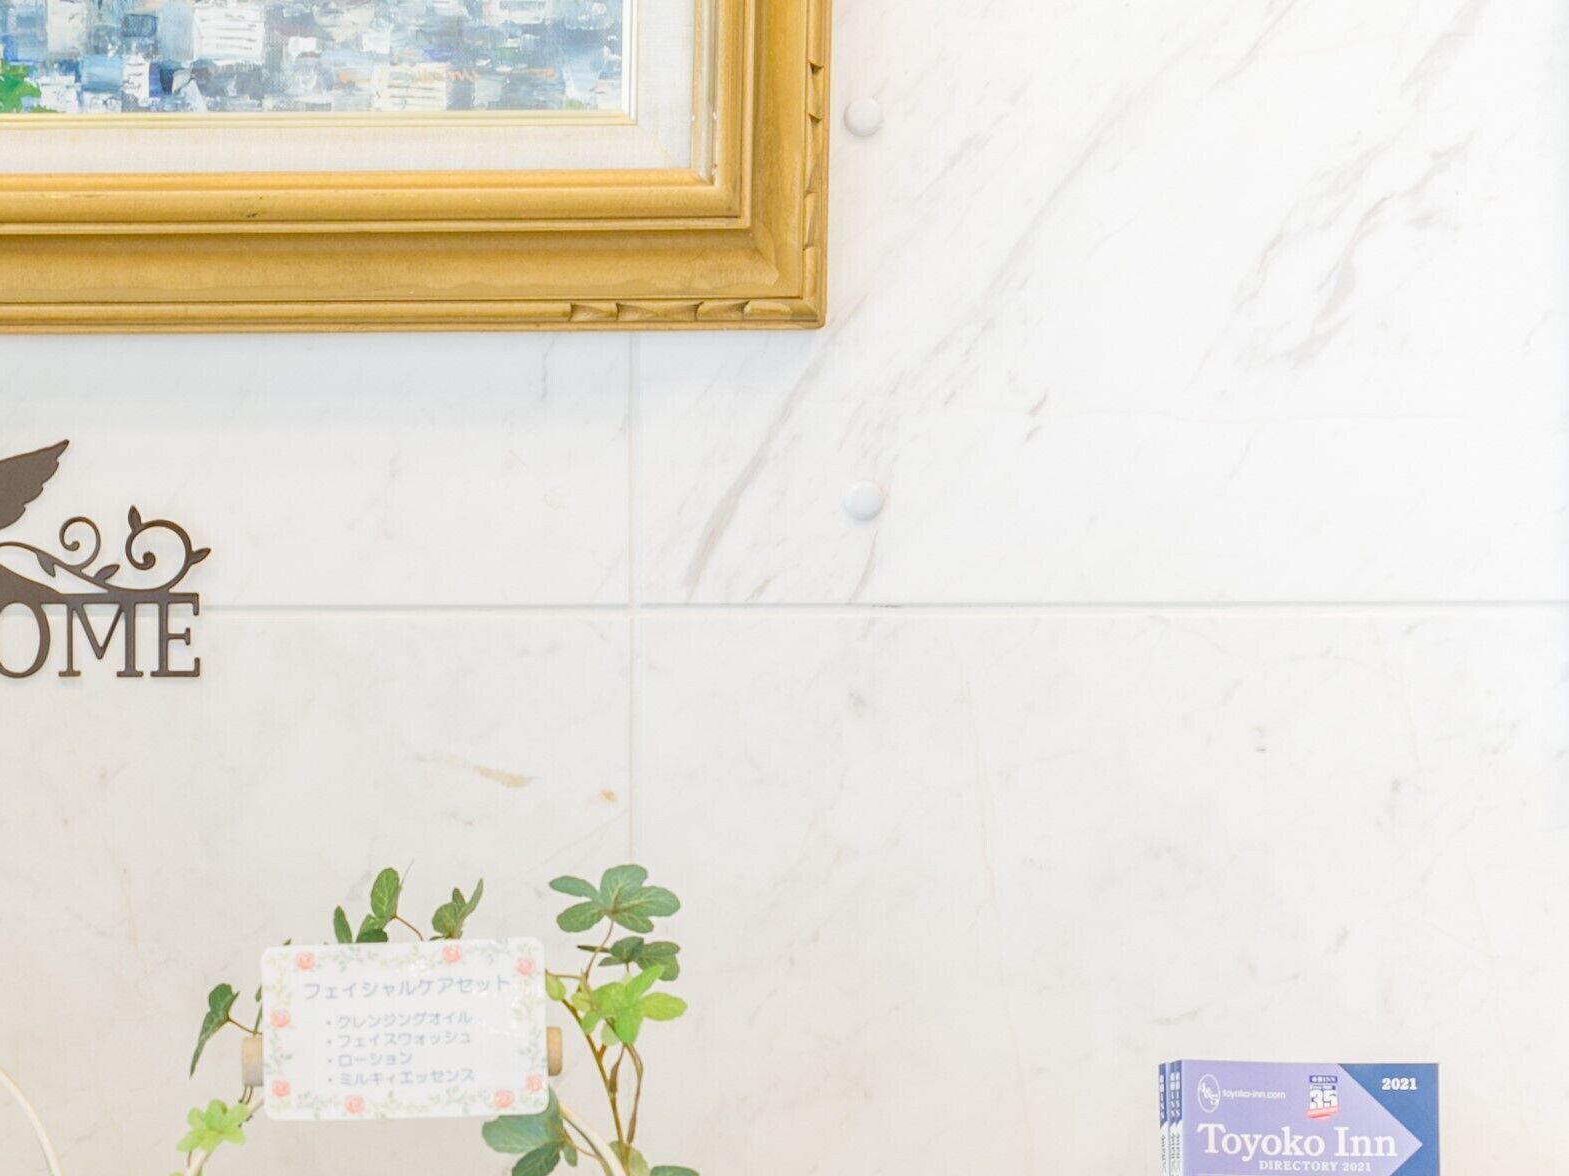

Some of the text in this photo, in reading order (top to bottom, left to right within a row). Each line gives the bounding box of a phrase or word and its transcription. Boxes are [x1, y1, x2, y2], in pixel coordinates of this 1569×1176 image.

[303, 975, 510, 1000] フェイシャルケアセット
[1381, 1077, 1418, 1091] 2021
[1197, 1123, 1398, 1162] Toyoko Inn
[1259, 1160, 1371, 1172] DIRECTORY 2021
